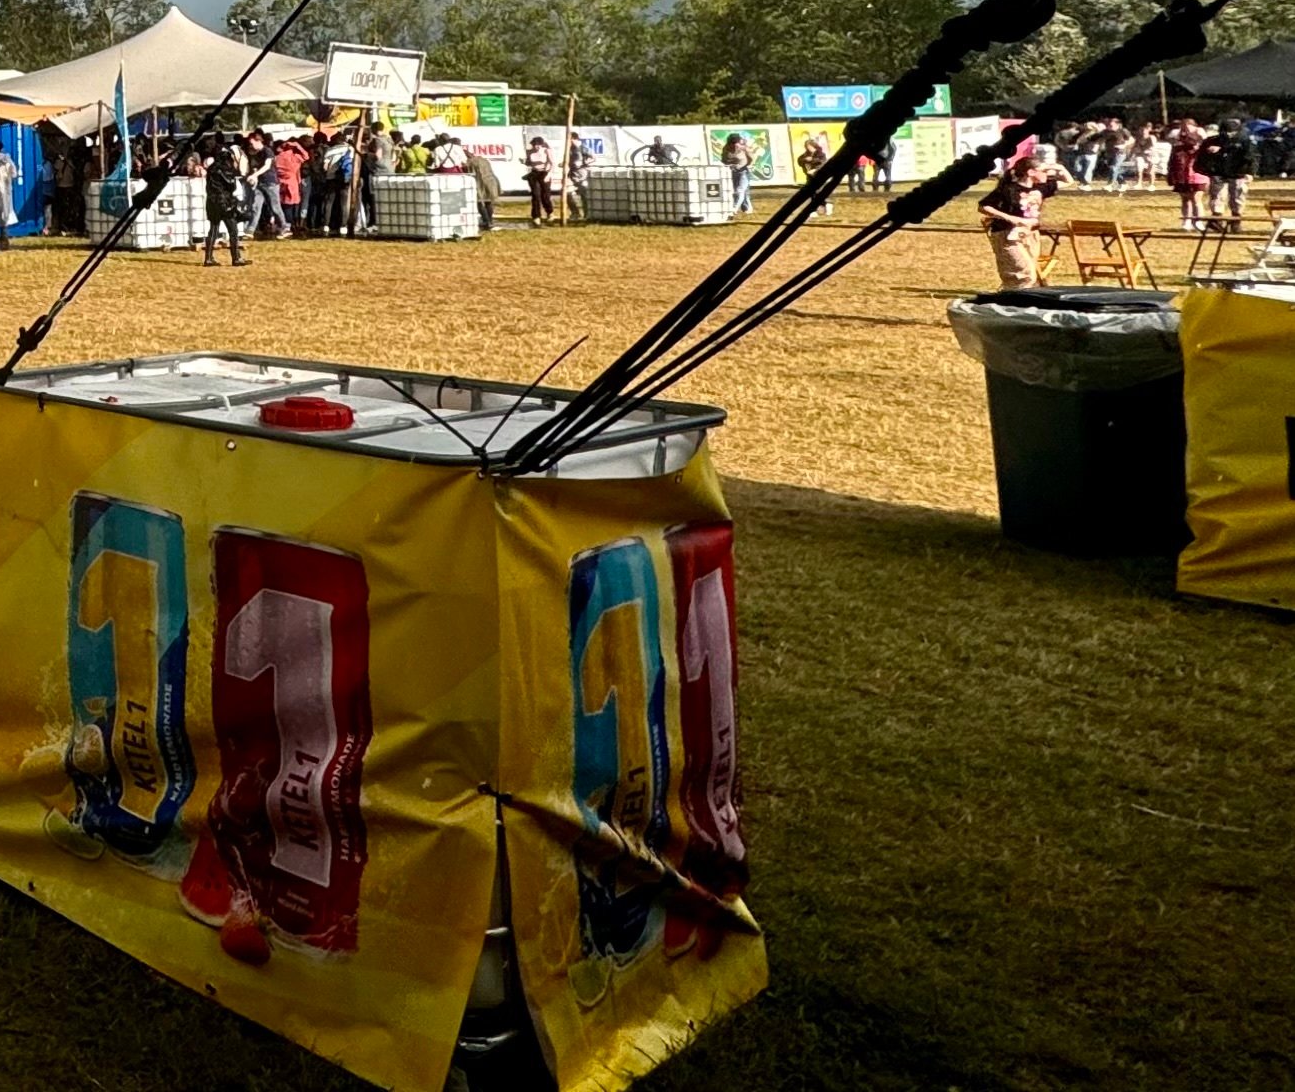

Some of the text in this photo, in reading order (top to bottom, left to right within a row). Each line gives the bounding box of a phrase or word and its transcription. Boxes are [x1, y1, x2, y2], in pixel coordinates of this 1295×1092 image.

[351, 72, 390, 90] LOOPUYT
[122, 700, 157, 794] KETEL 1
[163, 683, 179, 761] LEMONADE
[169, 762, 183, 802] HARD
[295, 750, 319, 765] 1
[281, 771, 319, 852] KETEL
[712, 742, 735, 836] KETEL
[339, 820, 351, 861] HAR
